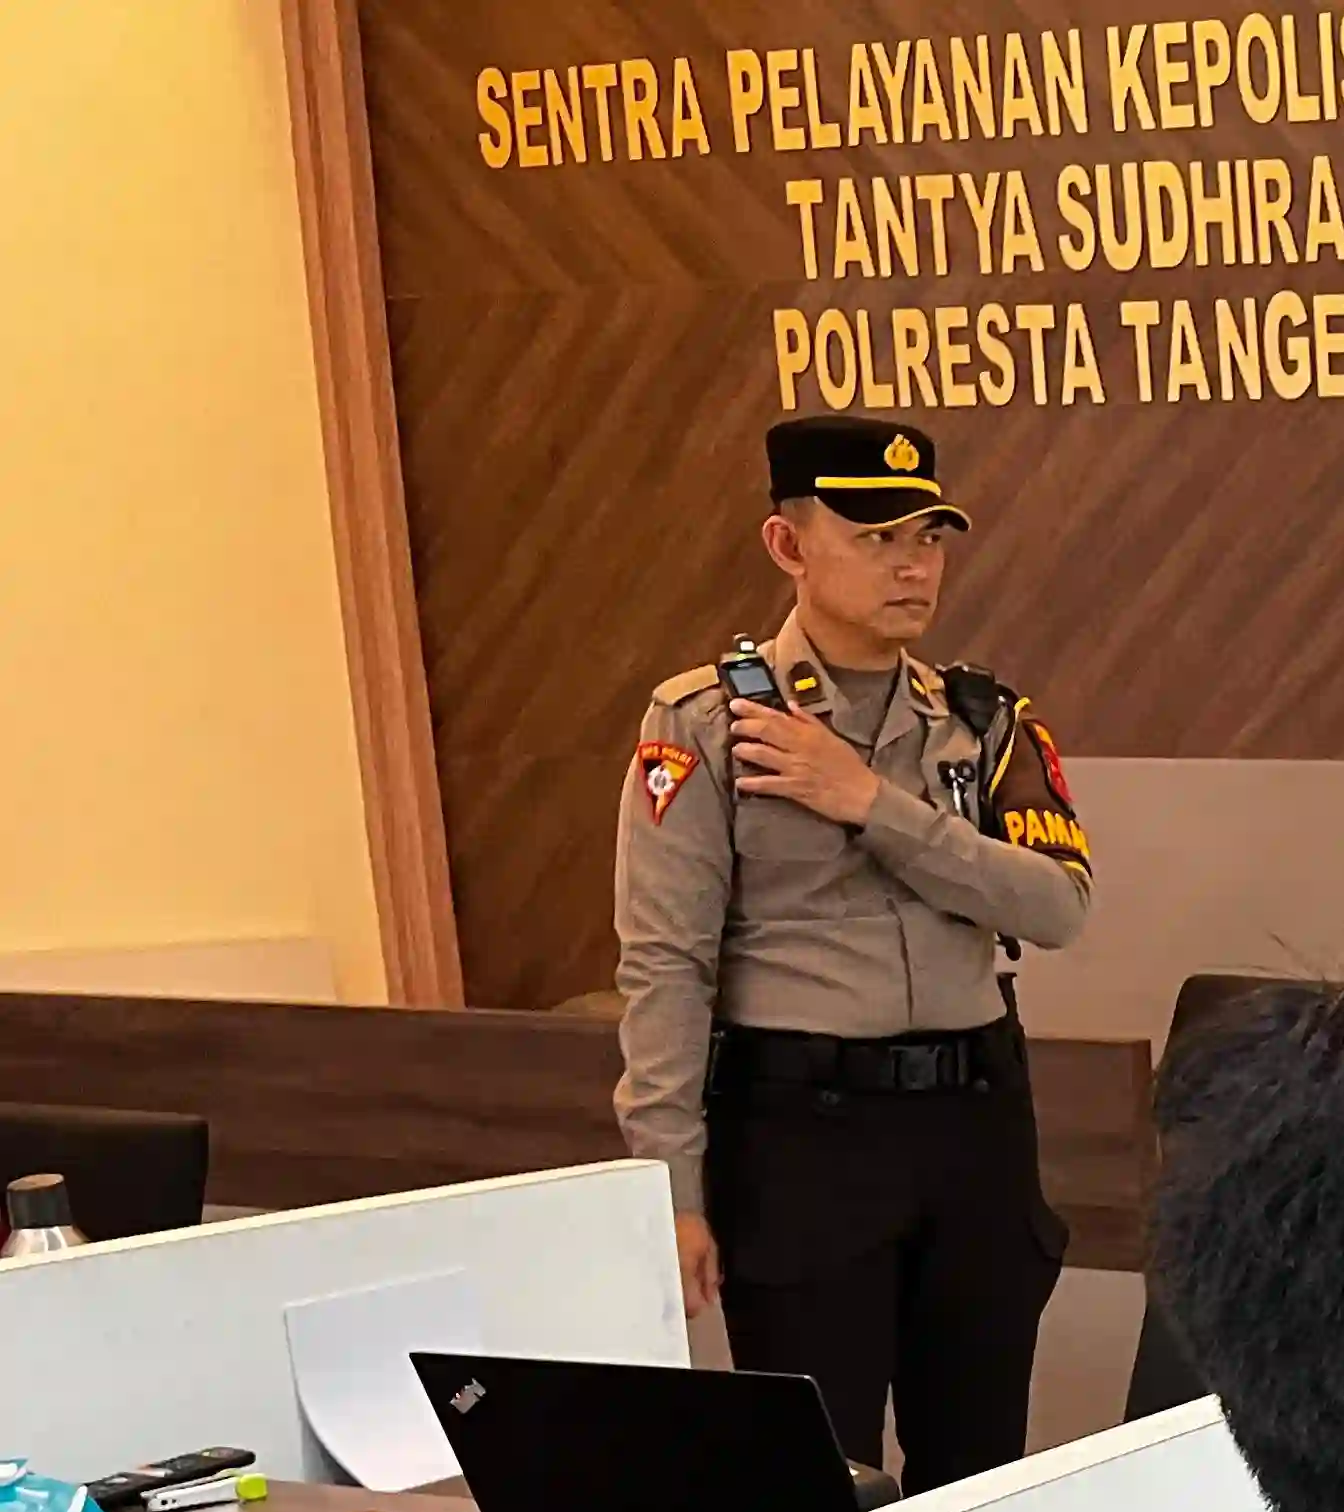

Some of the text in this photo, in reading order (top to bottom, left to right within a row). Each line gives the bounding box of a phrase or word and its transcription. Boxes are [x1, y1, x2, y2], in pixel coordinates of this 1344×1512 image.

[475, 57, 712, 170] SENTRA
[725, 27, 1089, 153] PELAYANAN
[785, 170, 1046, 280] TANTYA
[772, 302, 1107, 411] POLRESTA
